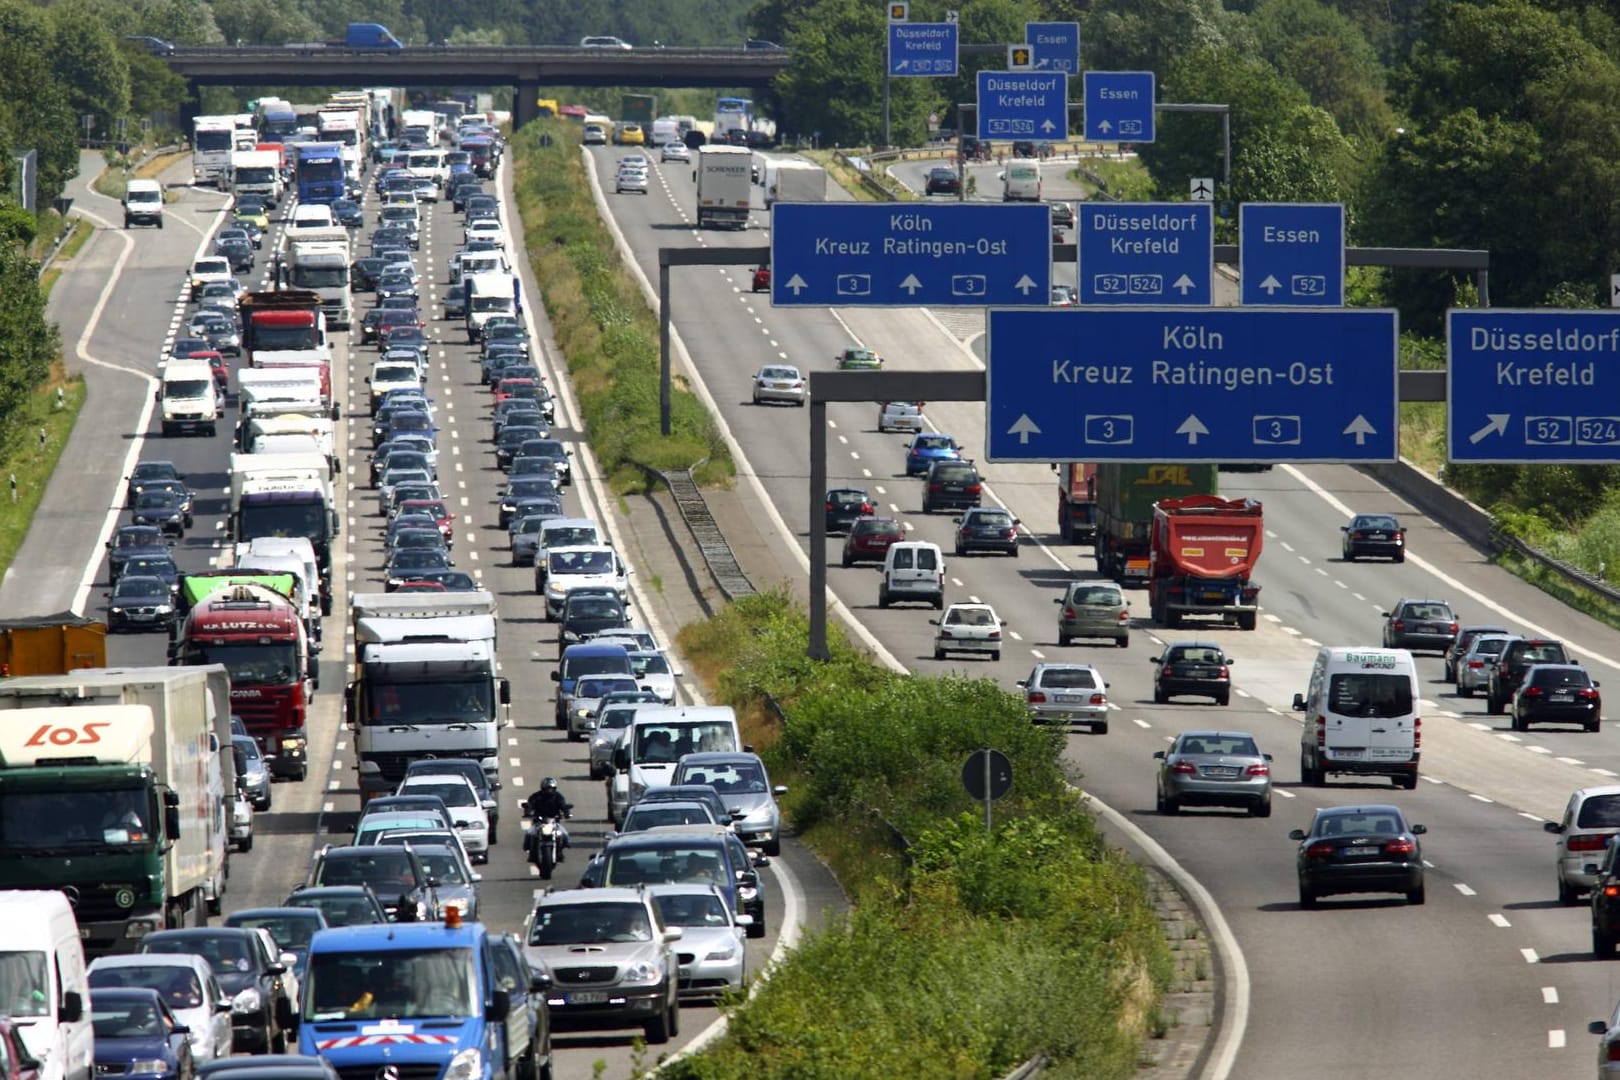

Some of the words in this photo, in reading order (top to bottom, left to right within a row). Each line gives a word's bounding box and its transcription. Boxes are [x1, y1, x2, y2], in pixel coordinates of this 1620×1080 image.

[896, 28, 950, 39] Düsseldorf
[1036, 34, 1068, 45] Essen
[905, 40, 942, 51] Krefeld
[987, 78, 1057, 92] Düsseldorf
[1099, 87, 1139, 100] Essen
[998, 94, 1046, 107] Krefeld
[890, 214, 933, 232] Köln
[1093, 213, 1197, 231] Düsseldorf
[1263, 225, 1320, 243] Essen
[815, 238, 870, 255] Kreuz
[883, 238, 1007, 259] Ratingen-Ost
[1111, 237, 1179, 254] Krefeld
[848, 277, 858, 291] 3
[965, 277, 975, 291] 3
[1102, 277, 1120, 292] 52
[1132, 277, 1159, 292] 524
[1300, 277, 1318, 292] 52
[1163, 325, 1223, 350] Köln
[1471, 327, 1619, 352] Düsseldorf
[1053, 359, 1133, 385] Kreuz
[1152, 360, 1334, 390] Ratingen-Ost
[1497, 361, 1594, 386] Krefeld
[1102, 421, 1115, 439] 3
[1270, 421, 1283, 439] 3
[1538, 422, 1560, 440] 52
[1582, 422, 1616, 440] 524
[1346, 653, 1396, 663] Baumann
